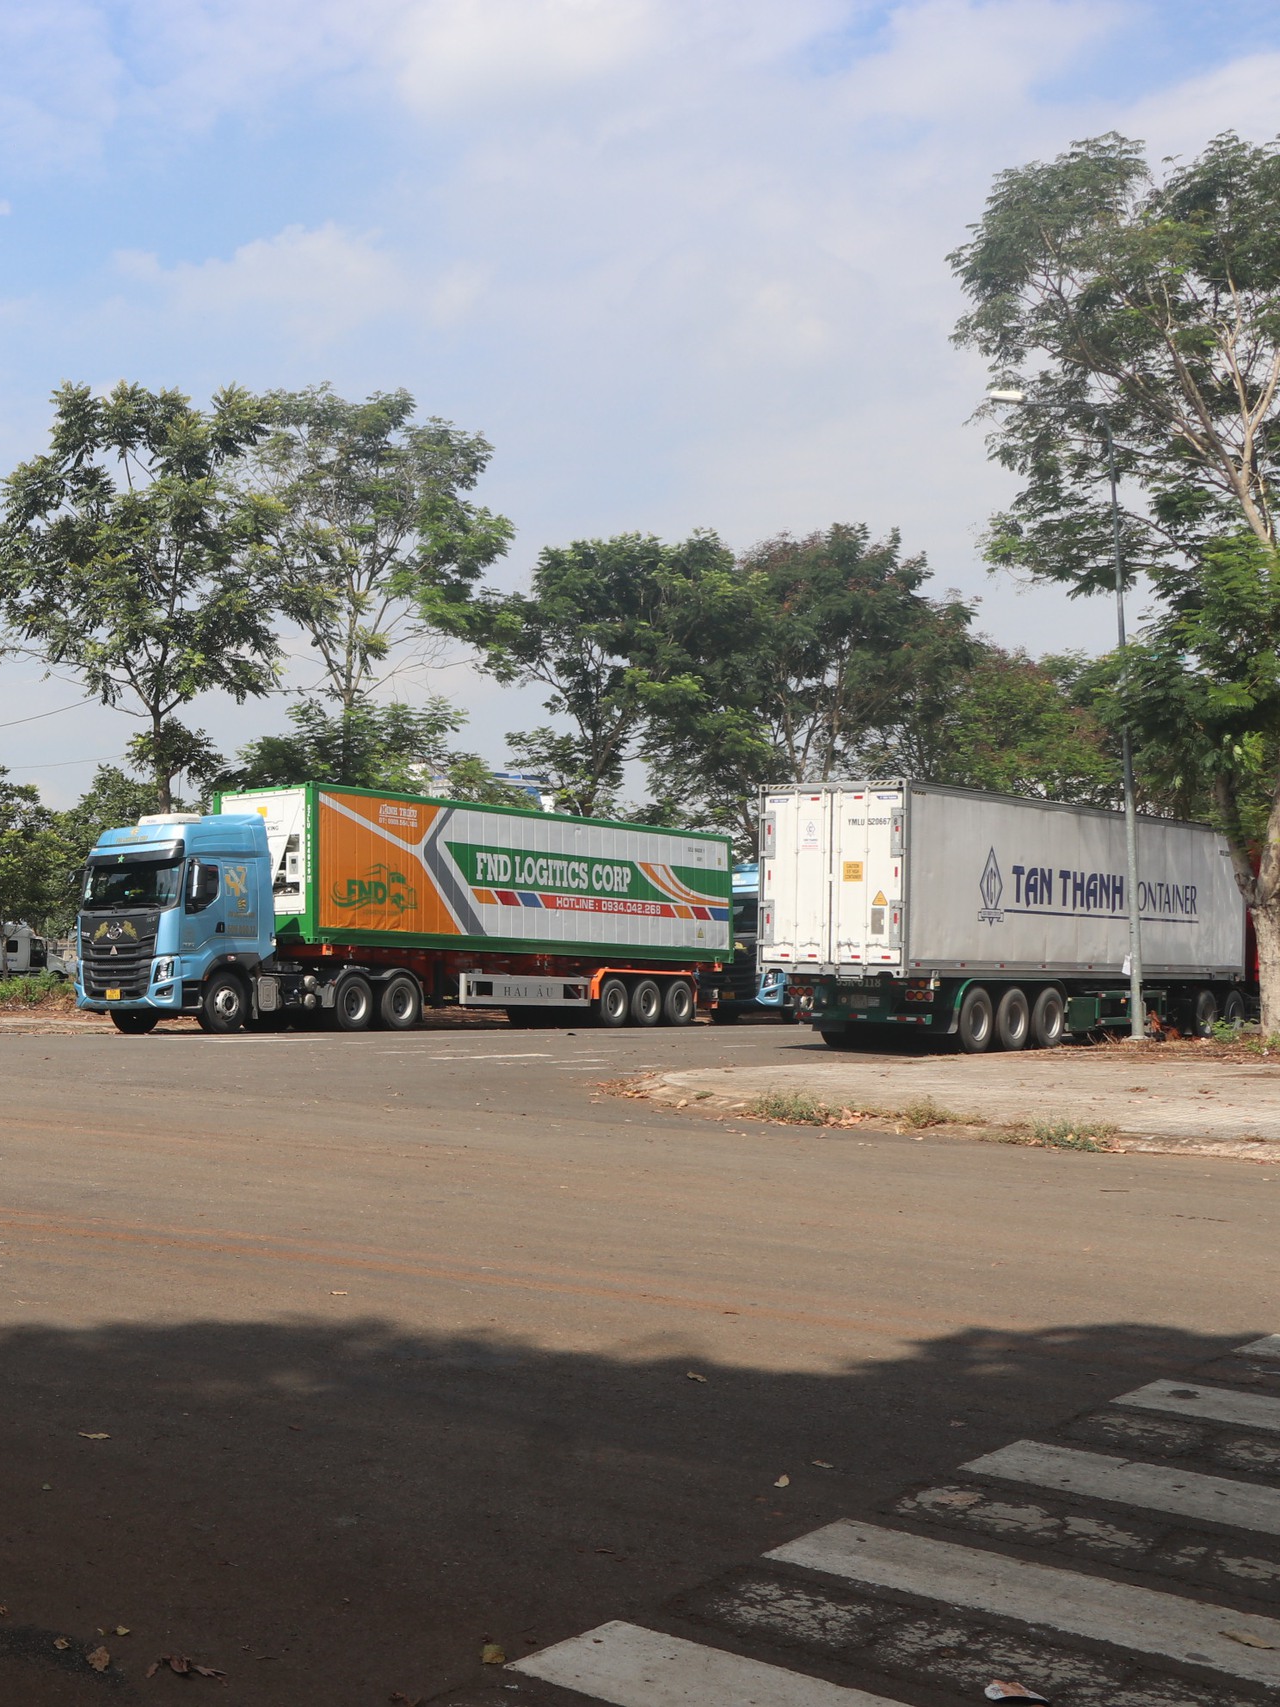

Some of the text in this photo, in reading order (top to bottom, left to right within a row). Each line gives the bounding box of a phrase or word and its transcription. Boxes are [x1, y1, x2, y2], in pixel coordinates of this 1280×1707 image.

[475, 852, 632, 893] FND LOGITICS CORP
[346, 879, 388, 905] FND
[555, 896, 662, 915] HOTLINE: 0934.042.268
[1012, 865, 1053, 908] TAN
[1059, 869, 1124, 914] THANH
[1128, 880, 1198, 915] ONTAINER
